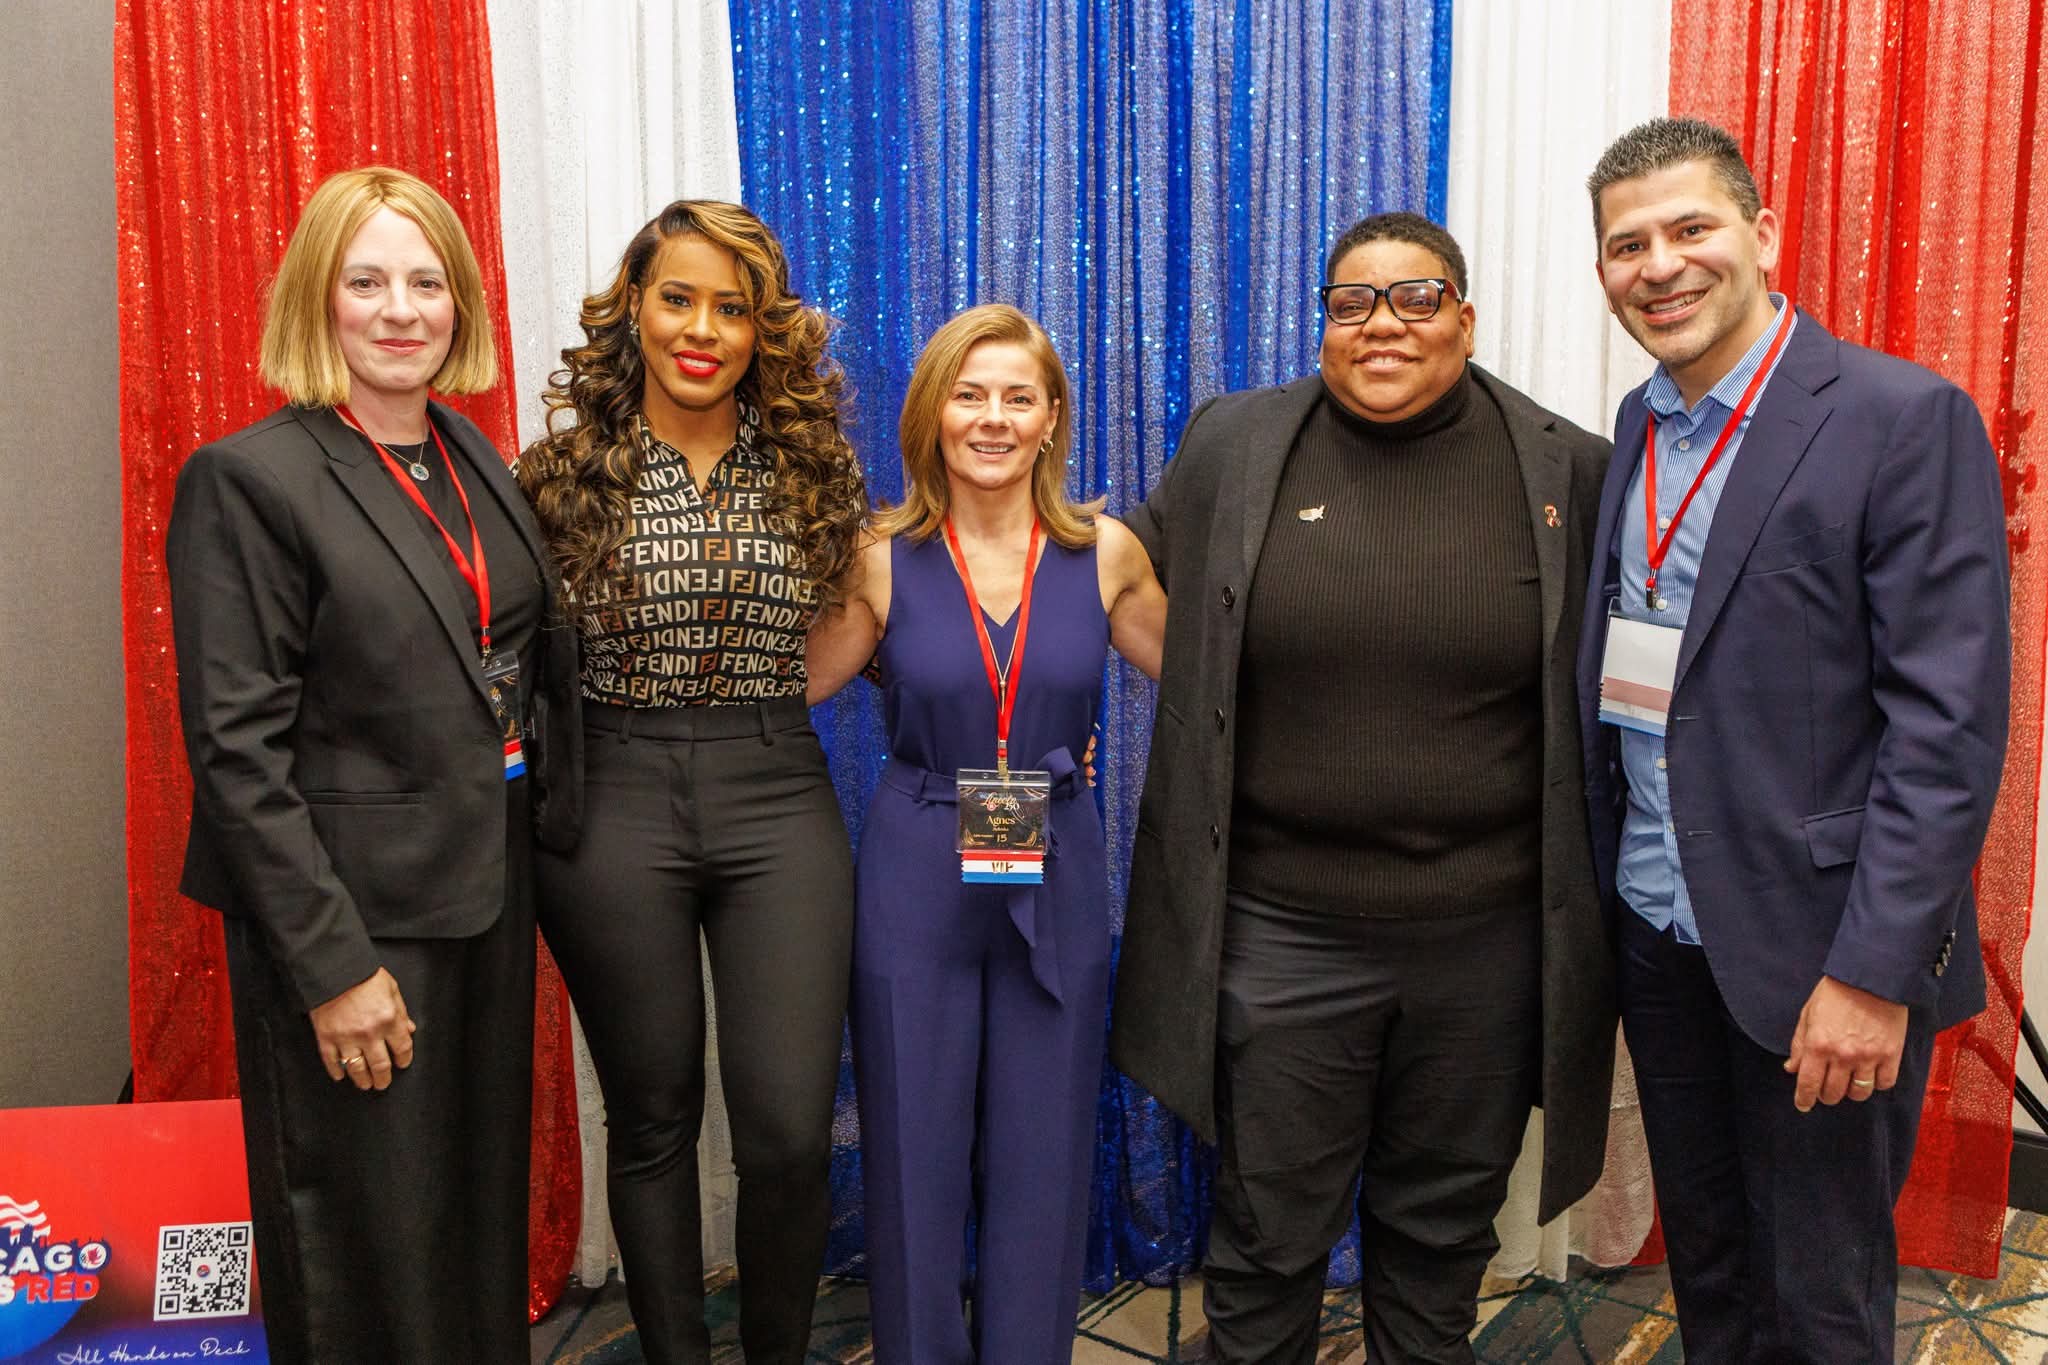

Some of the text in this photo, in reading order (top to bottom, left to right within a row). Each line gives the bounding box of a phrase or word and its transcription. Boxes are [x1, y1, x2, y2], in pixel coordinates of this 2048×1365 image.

[620, 539, 699, 568] FENDI
[644, 568, 724, 597] FENDI
[624, 599, 699, 630] FENDI
[731, 599, 801, 630] FENDI
[652, 626, 719, 649] FENDI
[743, 628, 798, 653] FENDI
[635, 652, 697, 676] FENDI
[720, 651, 778, 675] FENDI
[733, 677, 785, 698] FENDI
[985, 815, 1016, 827] Agnes
[997, 833, 1008, 843] 15
[26, 1272, 100, 1304] RED
[109, 1341, 171, 1363] Hands
[173, 1351, 196, 1360] on
[200, 1337, 250, 1358] Deck
